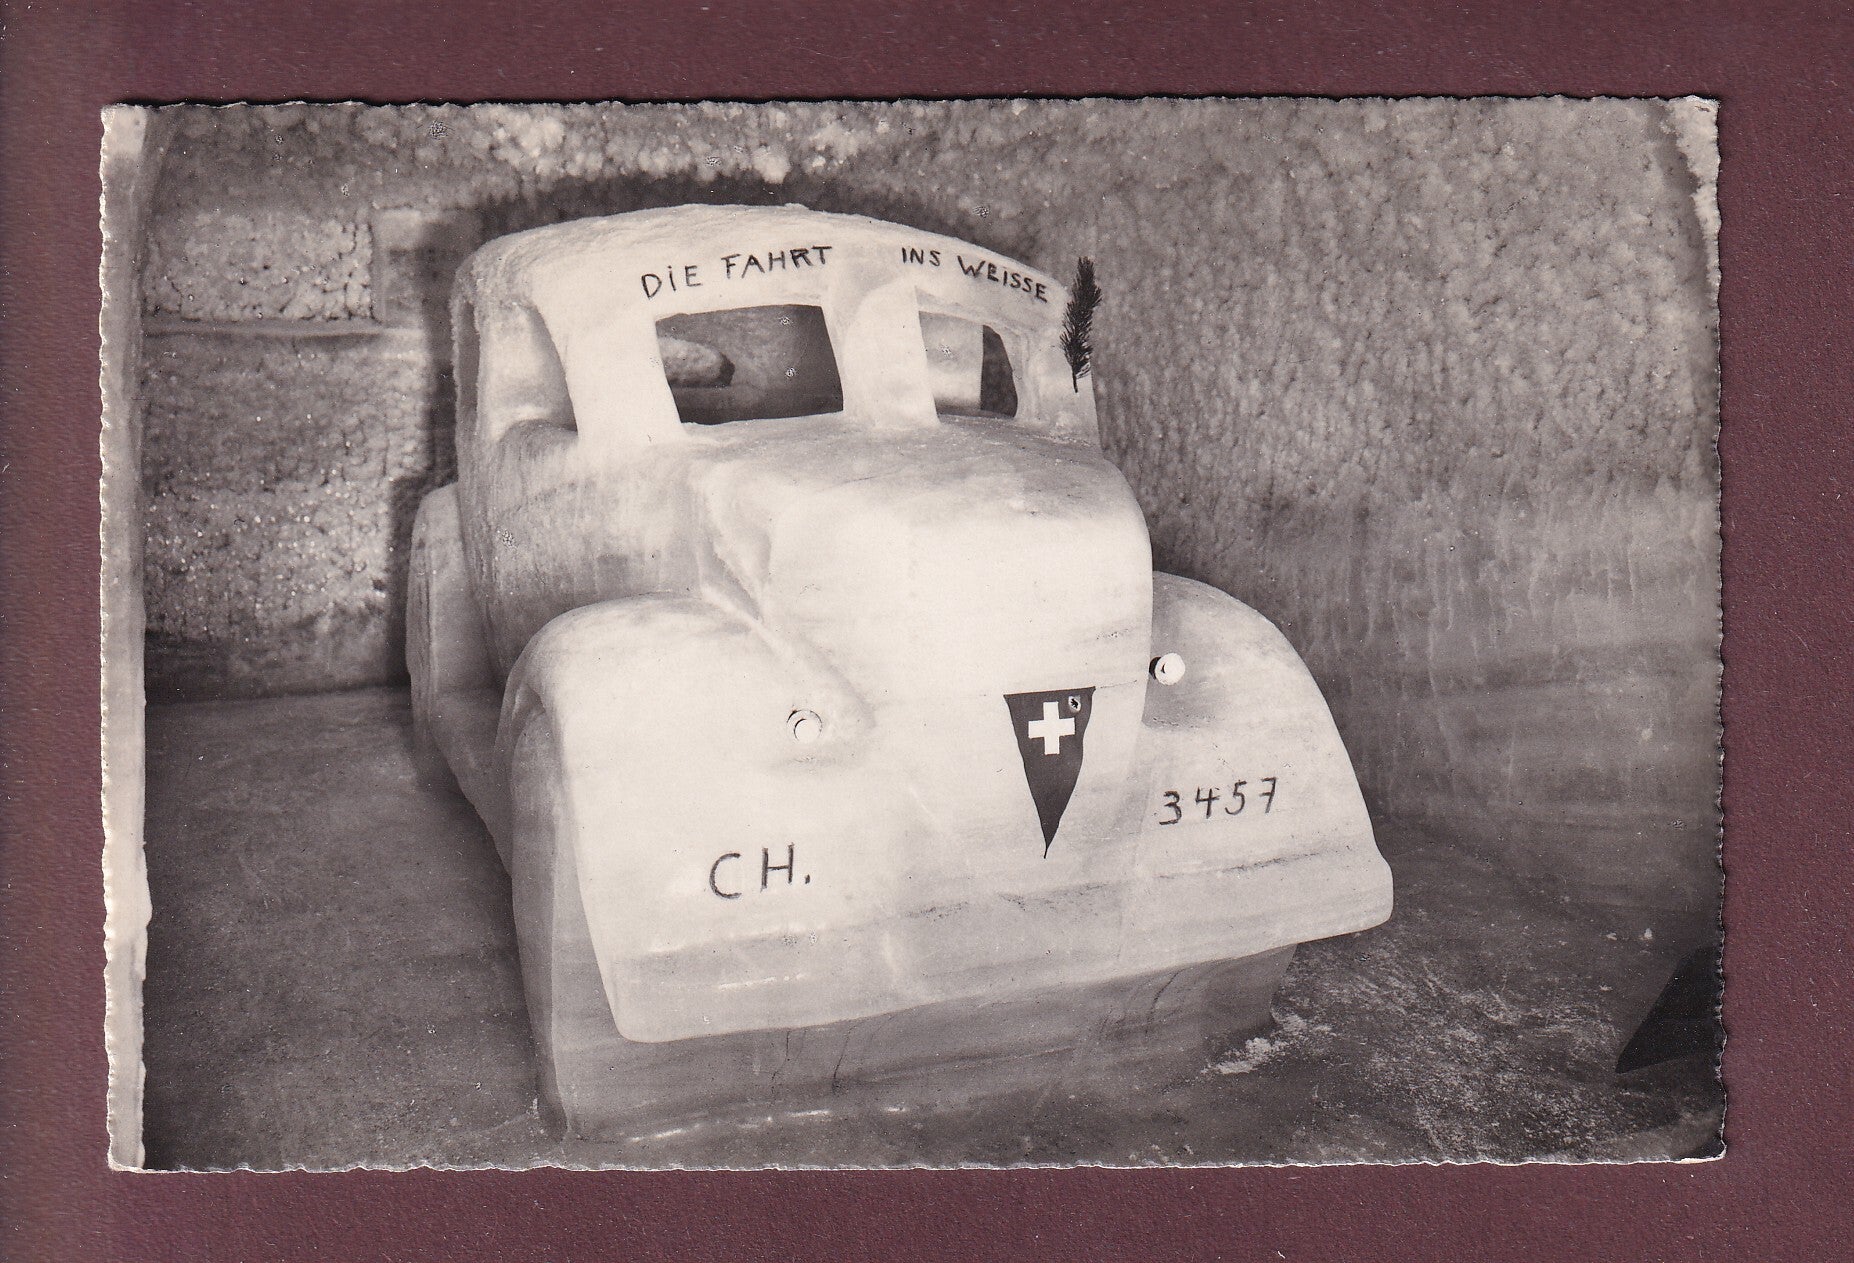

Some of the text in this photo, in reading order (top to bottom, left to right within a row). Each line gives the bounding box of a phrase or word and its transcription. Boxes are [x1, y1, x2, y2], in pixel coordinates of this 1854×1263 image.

[721, 246, 832, 279] FAHRT
[901, 247, 941, 267] INS
[957, 255, 1048, 302] WEISSE
[1159, 777, 1277, 825] 3457
[709, 843, 810, 899] CH.
